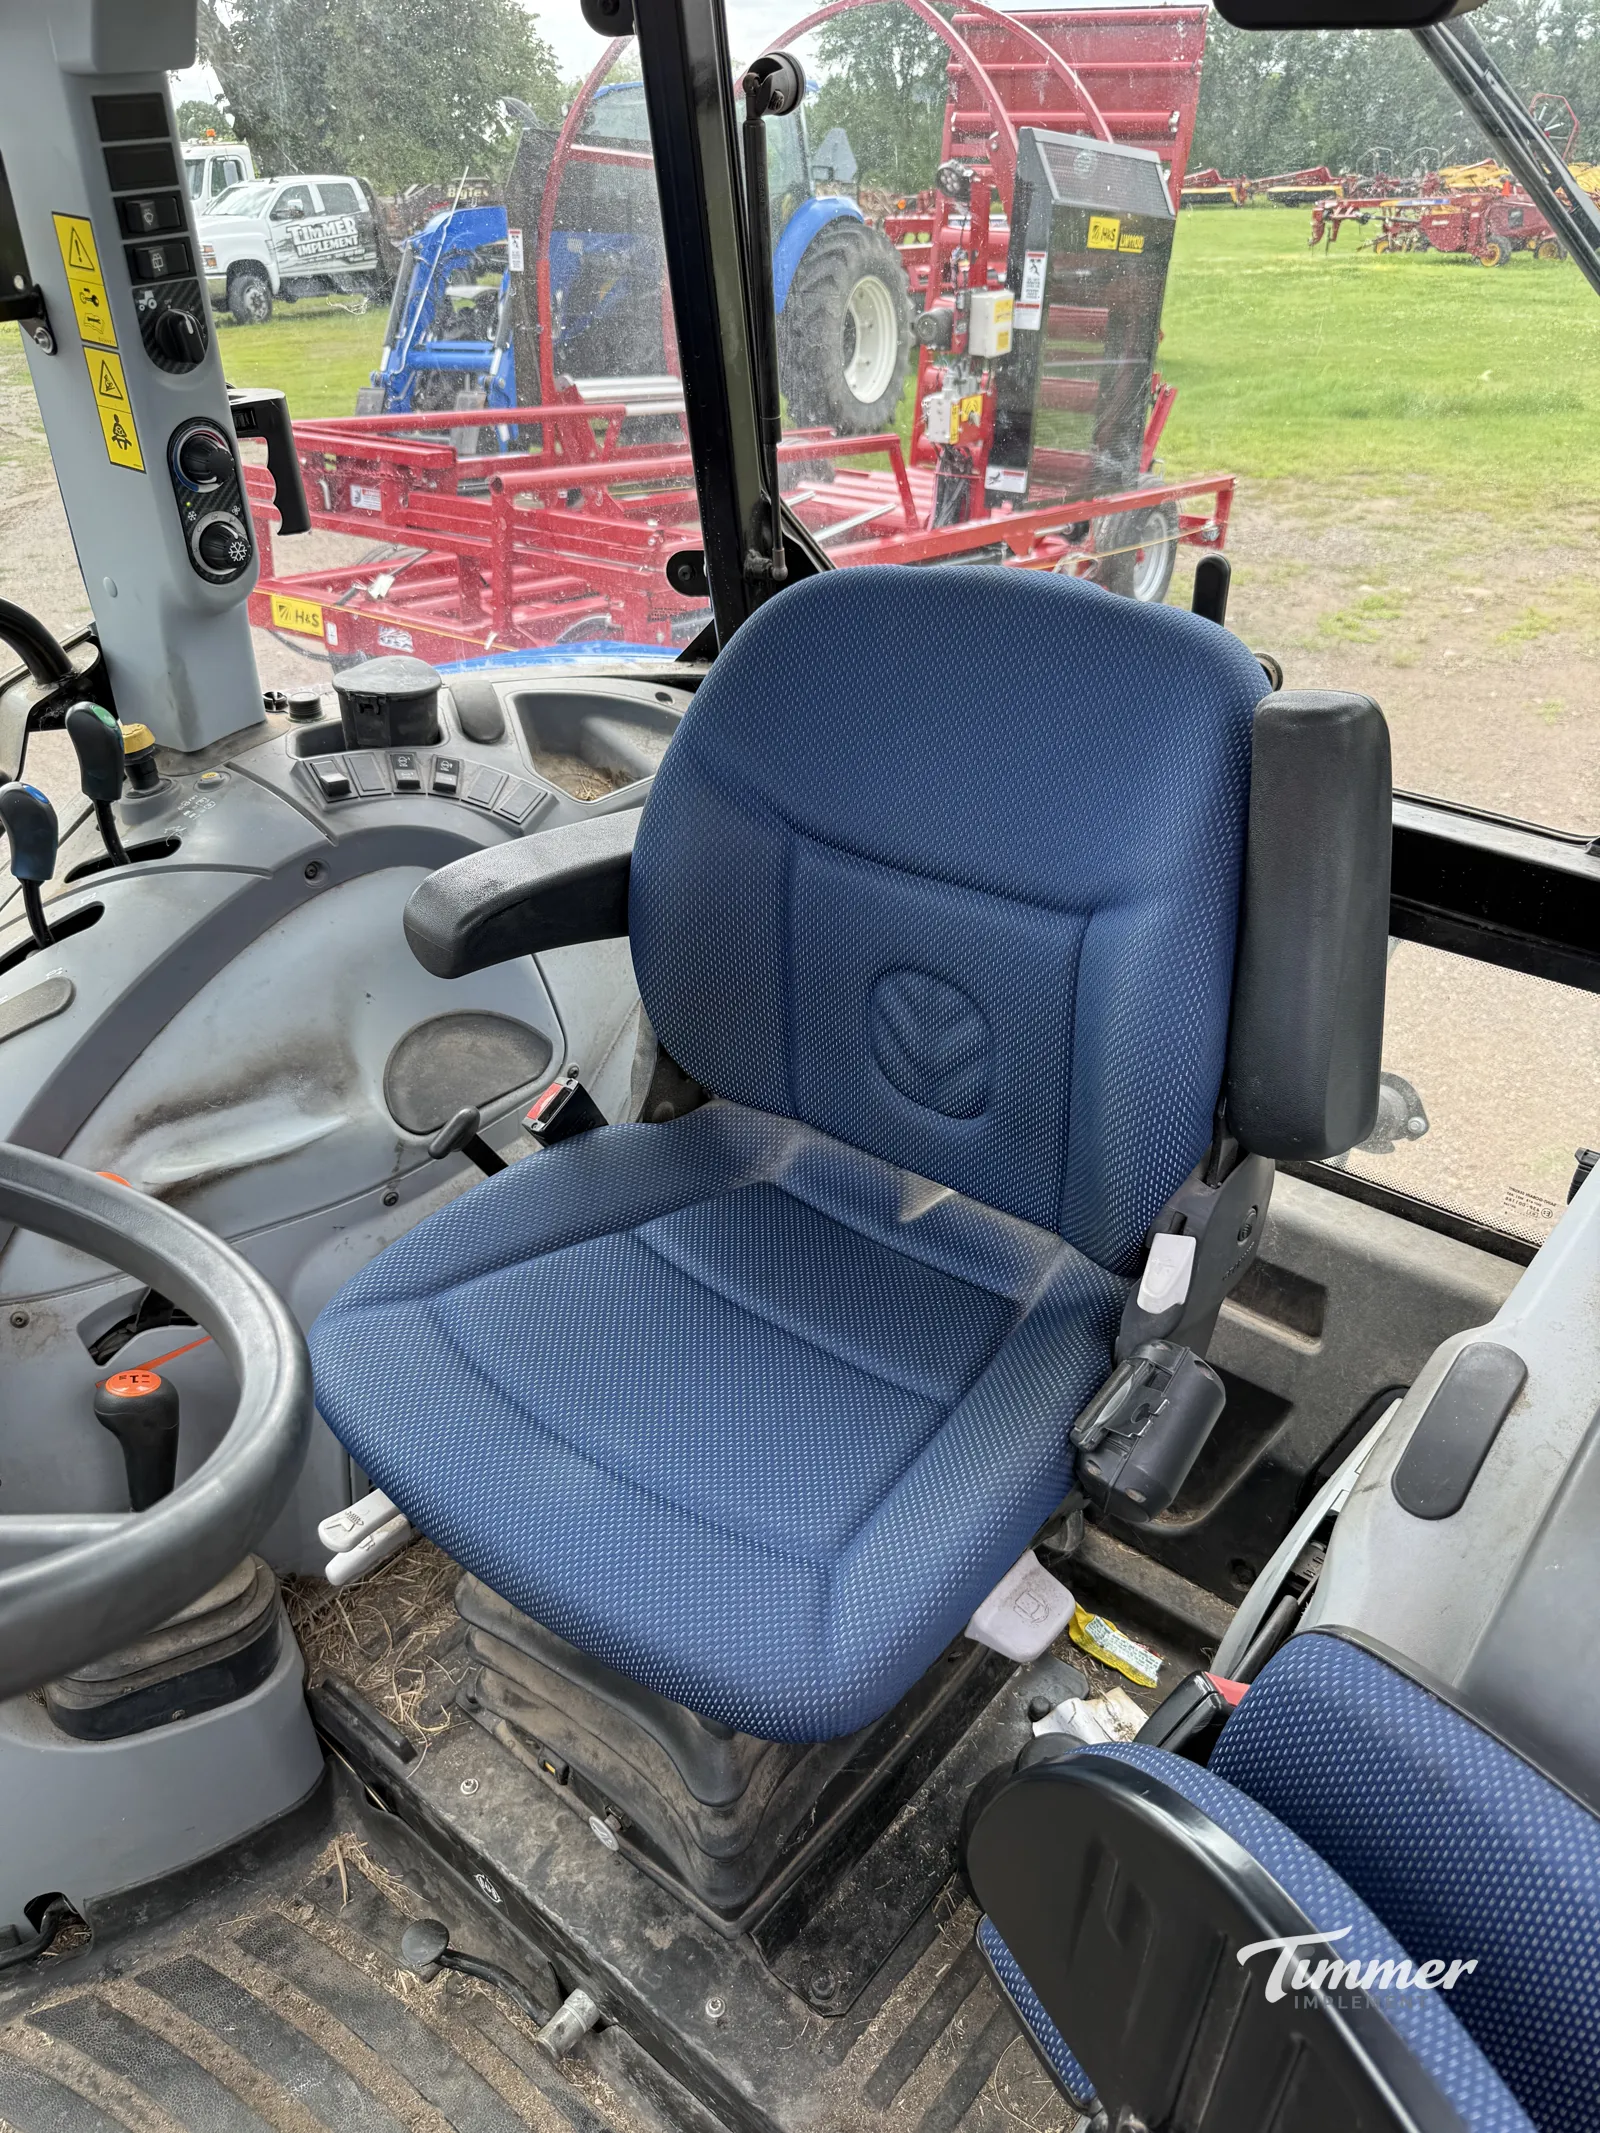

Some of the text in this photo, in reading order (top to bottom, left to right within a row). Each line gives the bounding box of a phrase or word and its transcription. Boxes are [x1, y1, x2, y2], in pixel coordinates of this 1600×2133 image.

[287, 217, 358, 246] TIMMER
[296, 235, 359, 256] IMPLEMENT
[295, 609, 320, 628] H&S
